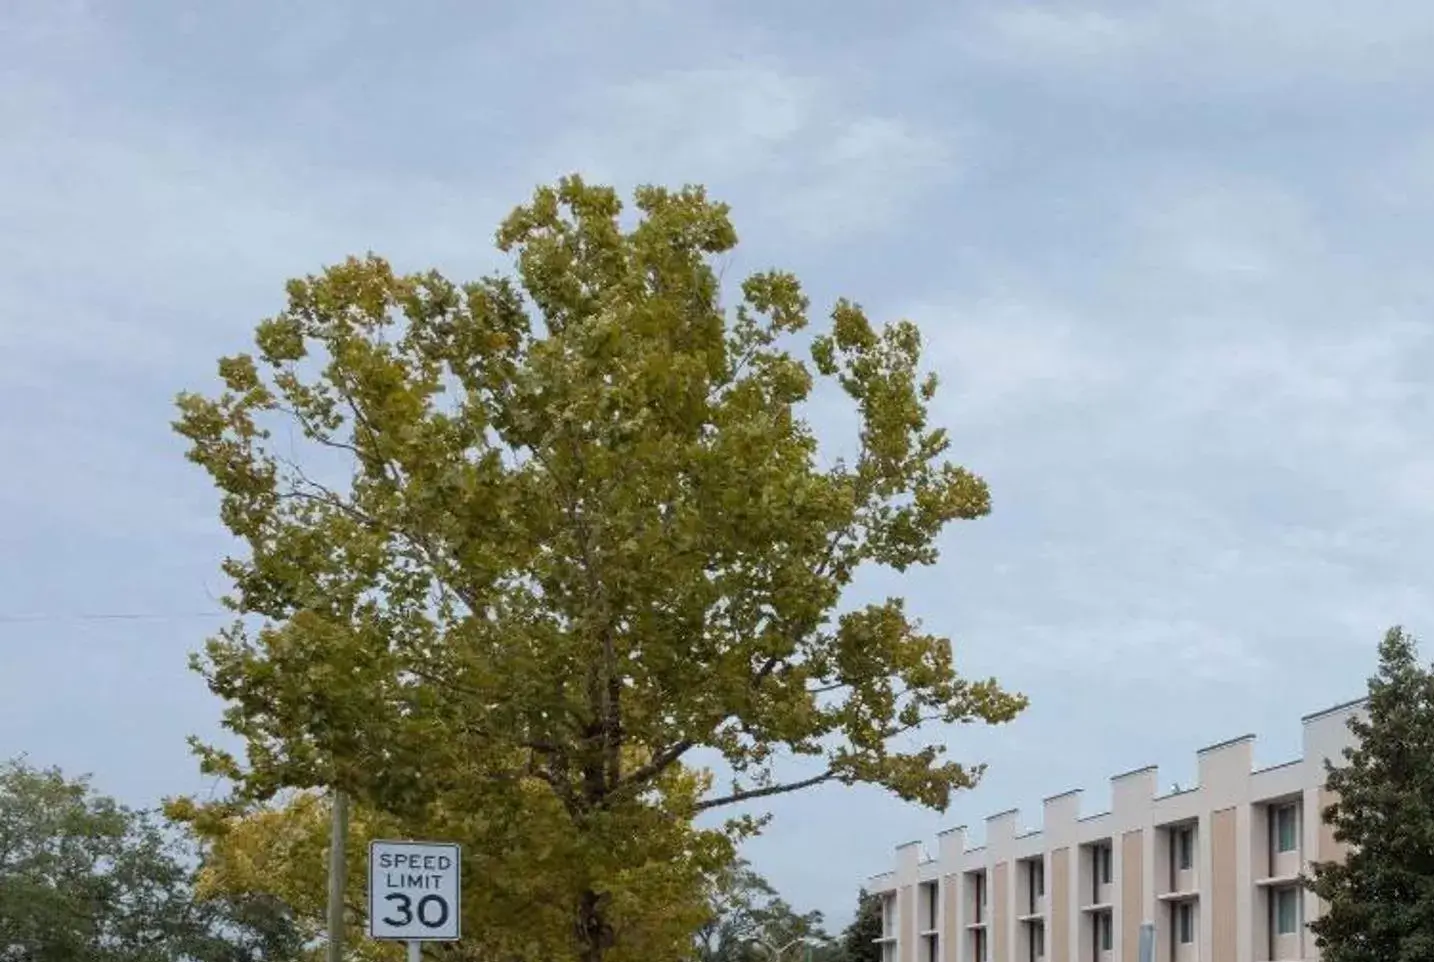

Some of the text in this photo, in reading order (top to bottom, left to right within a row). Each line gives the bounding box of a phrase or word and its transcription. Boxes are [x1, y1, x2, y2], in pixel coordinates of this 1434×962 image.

[380, 853, 452, 870] SPEED
[386, 873, 443, 890] LIMIT
[382, 892, 449, 928] 30
